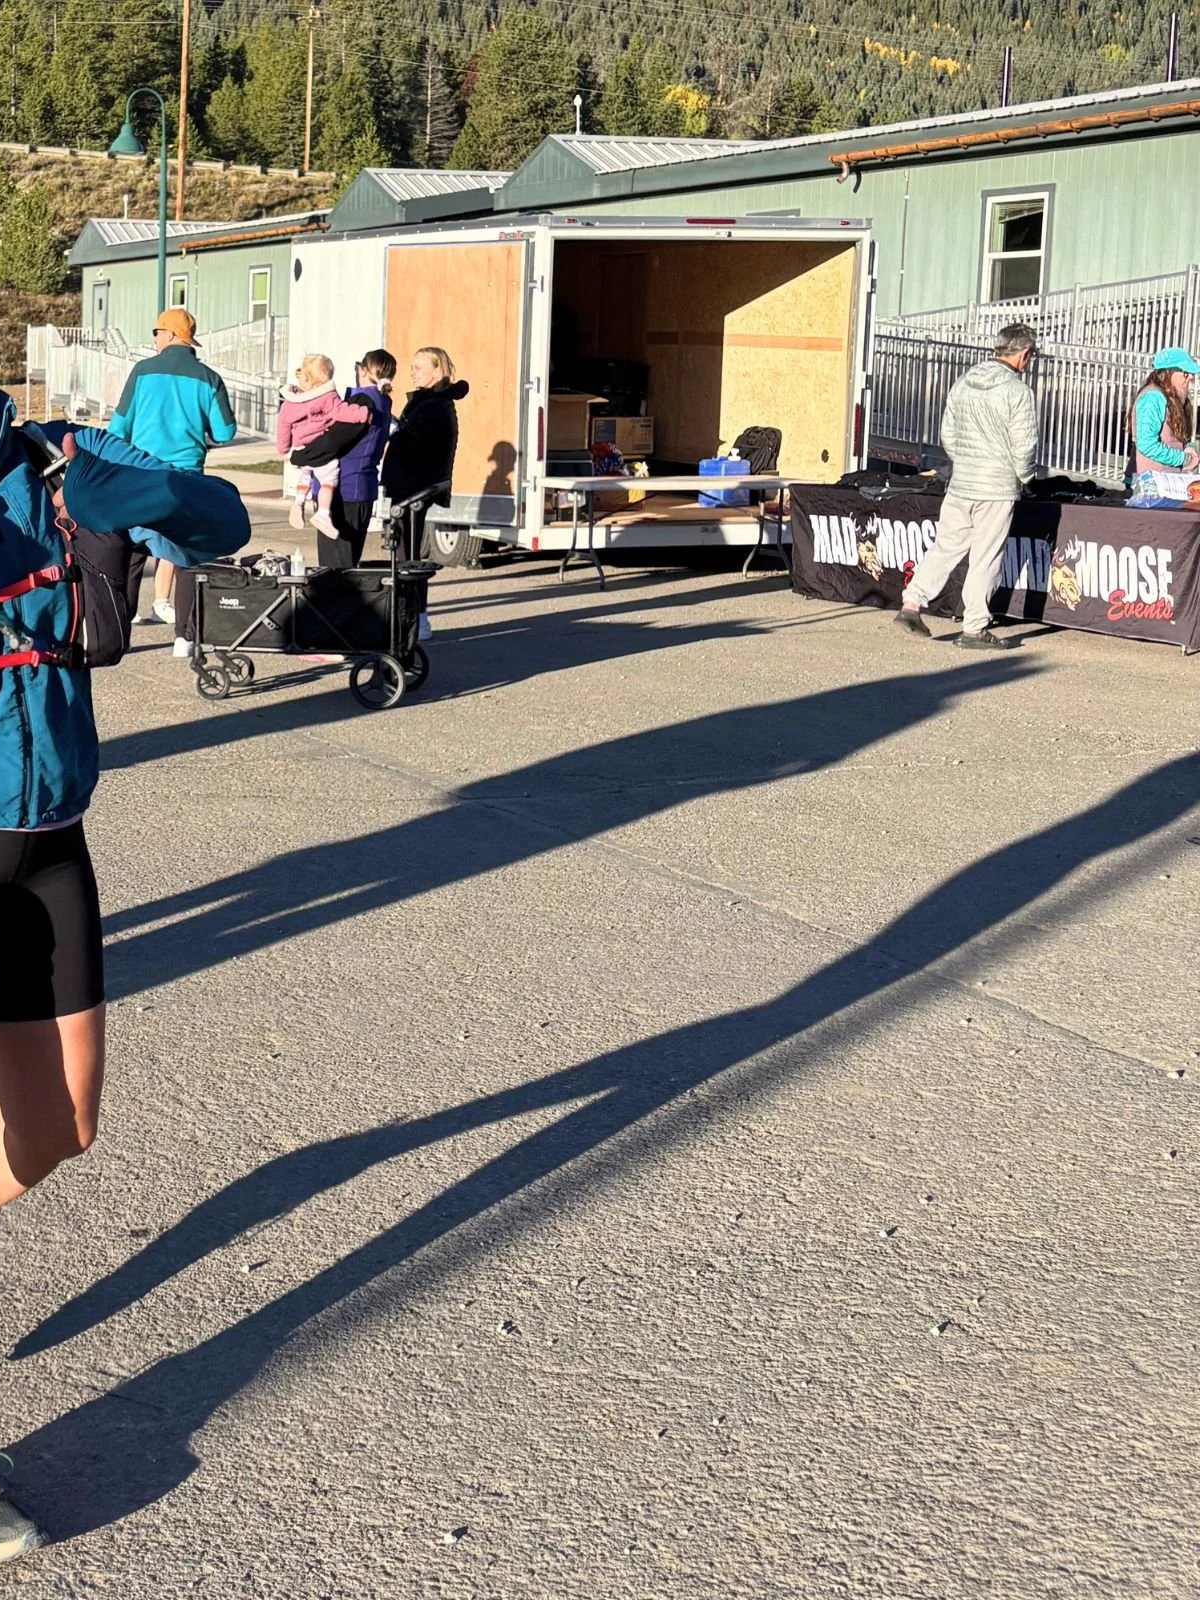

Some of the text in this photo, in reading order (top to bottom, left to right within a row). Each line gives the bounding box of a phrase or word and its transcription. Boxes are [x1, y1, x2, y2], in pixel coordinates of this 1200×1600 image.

[809, 515, 940, 574] MAD MOOS
[1001, 537, 1175, 607] MAD MOOSE
[219, 597, 240, 606] Jeep
[1107, 588, 1174, 622] Events
